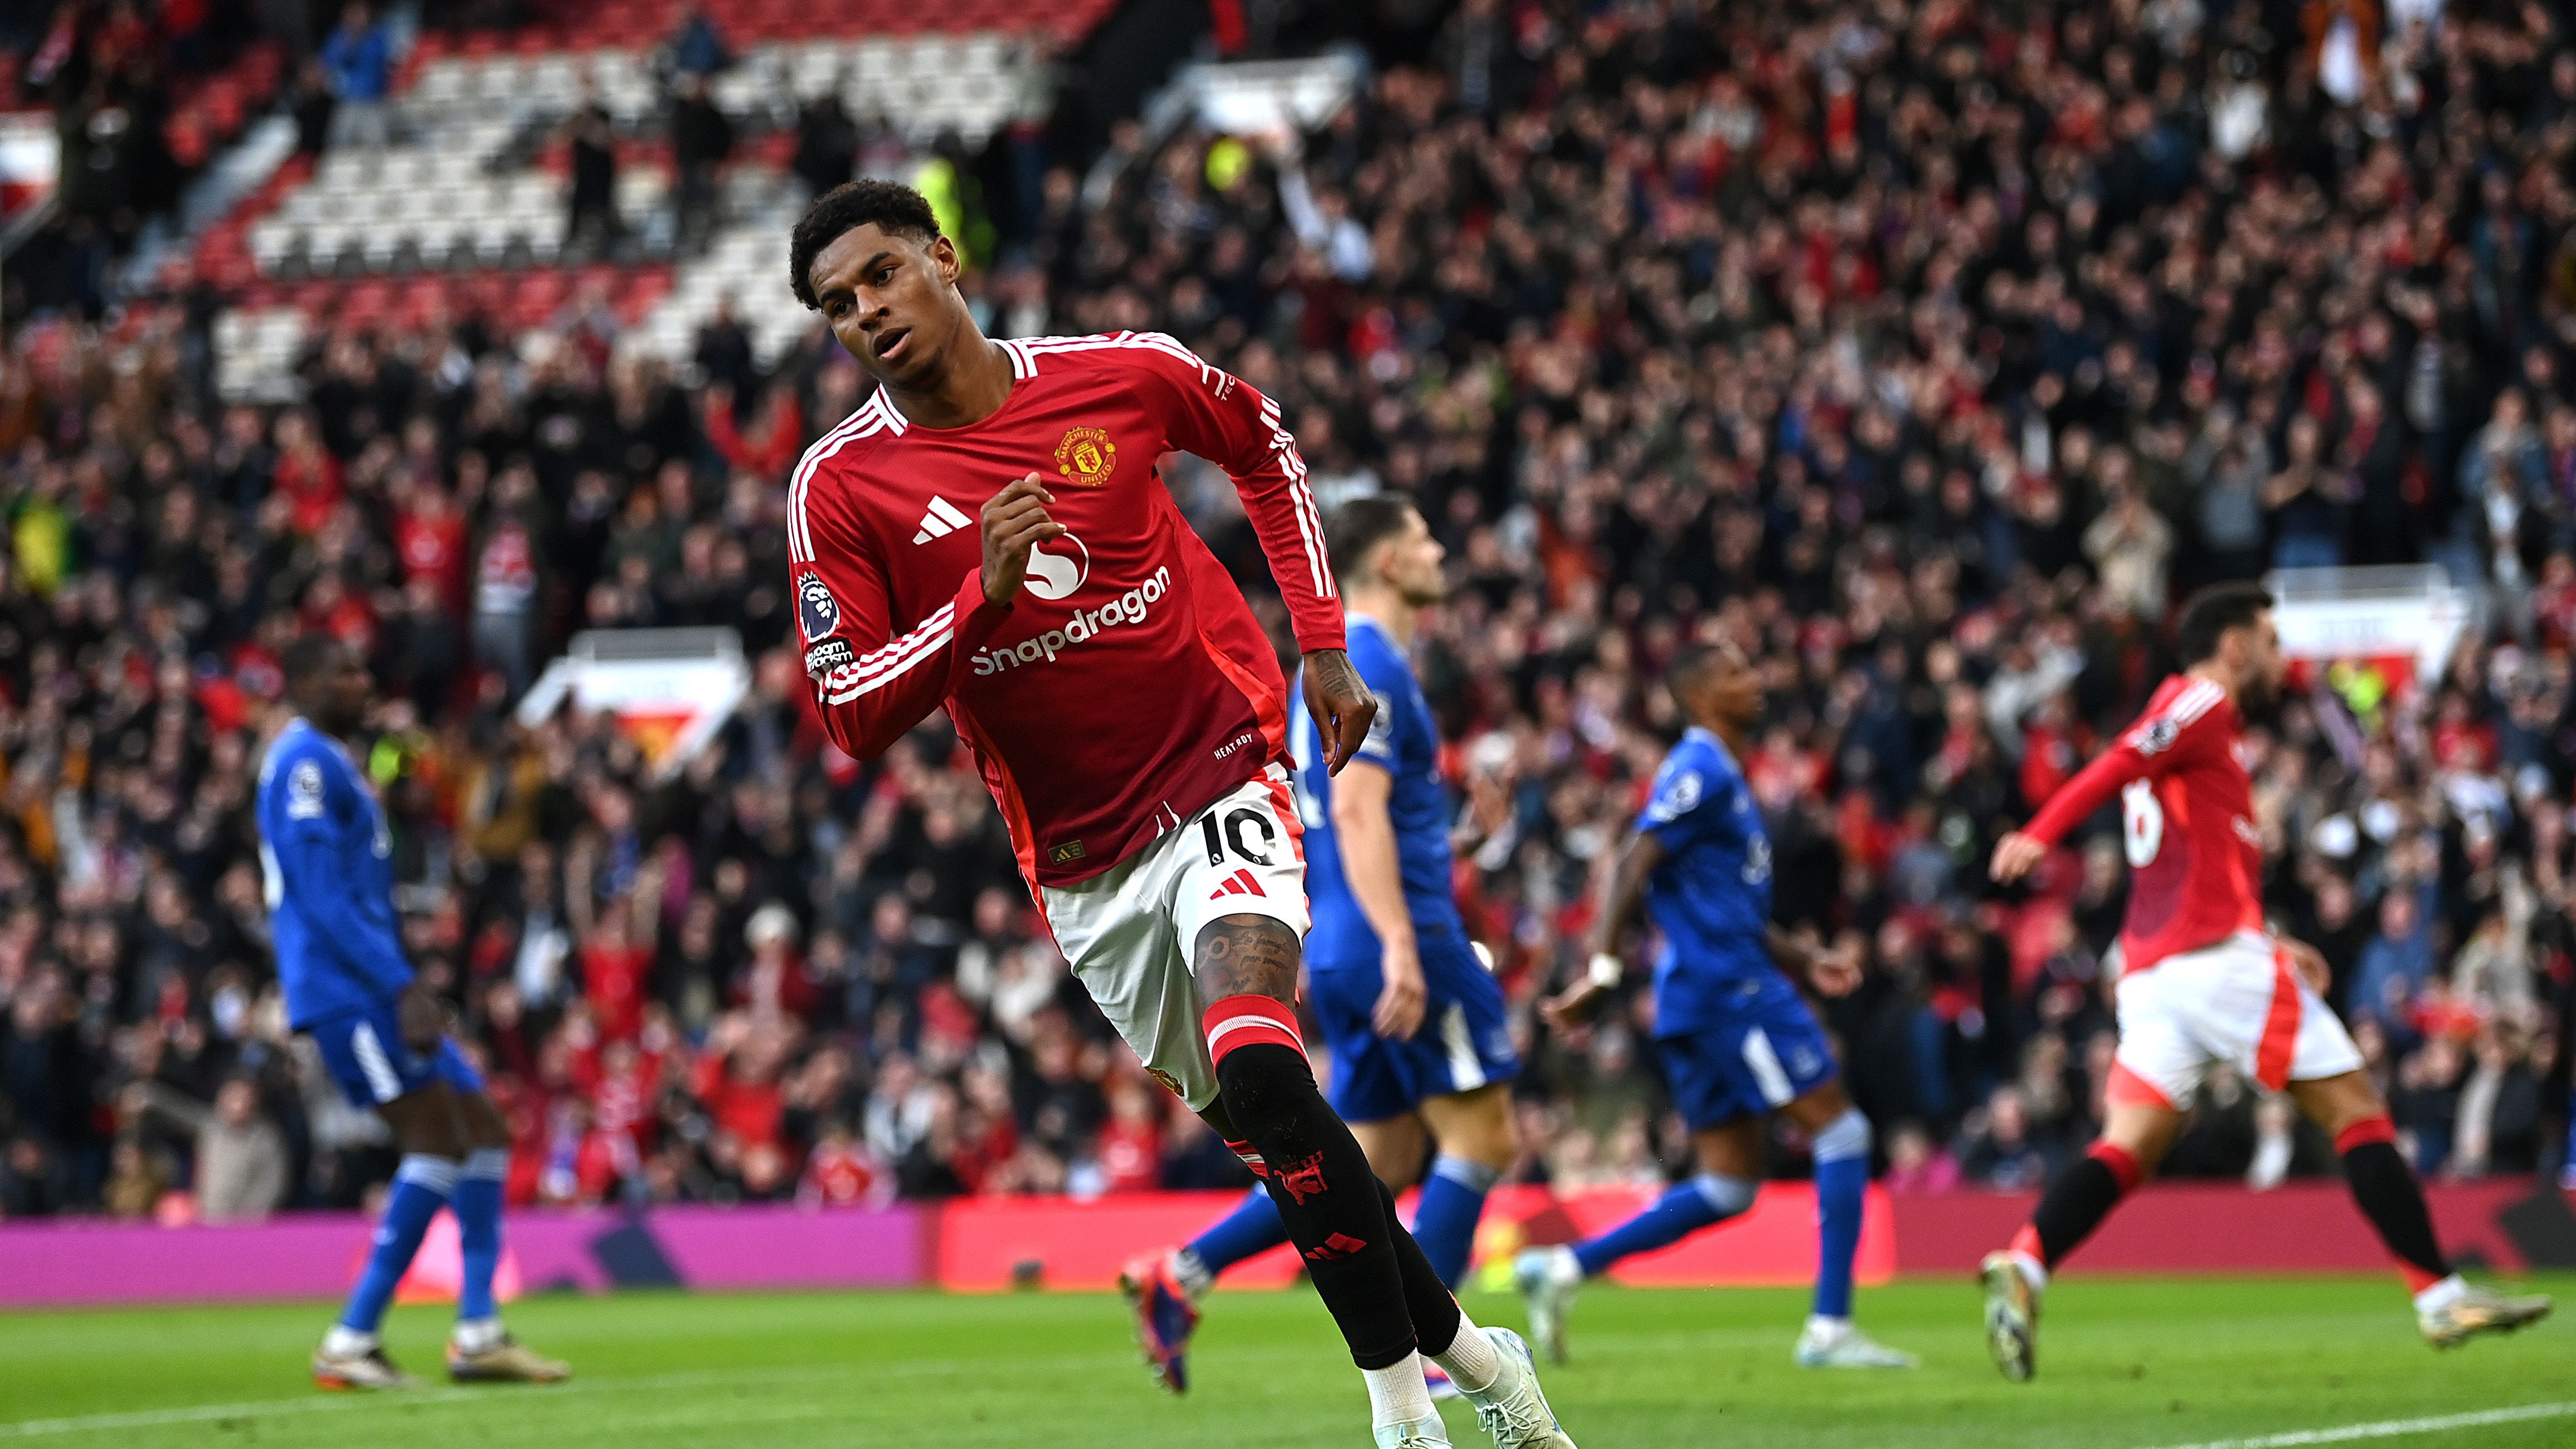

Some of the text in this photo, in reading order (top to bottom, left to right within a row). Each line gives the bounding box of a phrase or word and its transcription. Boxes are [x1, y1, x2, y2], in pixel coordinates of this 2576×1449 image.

[1059, 430, 1104, 459] MANCHESTER
[1081, 464, 1112, 483] UNITED
[971, 566, 1170, 675] Snapdragon
[1213, 733, 1252, 760] HEAT.RDY
[1194, 808, 1275, 867] 10
